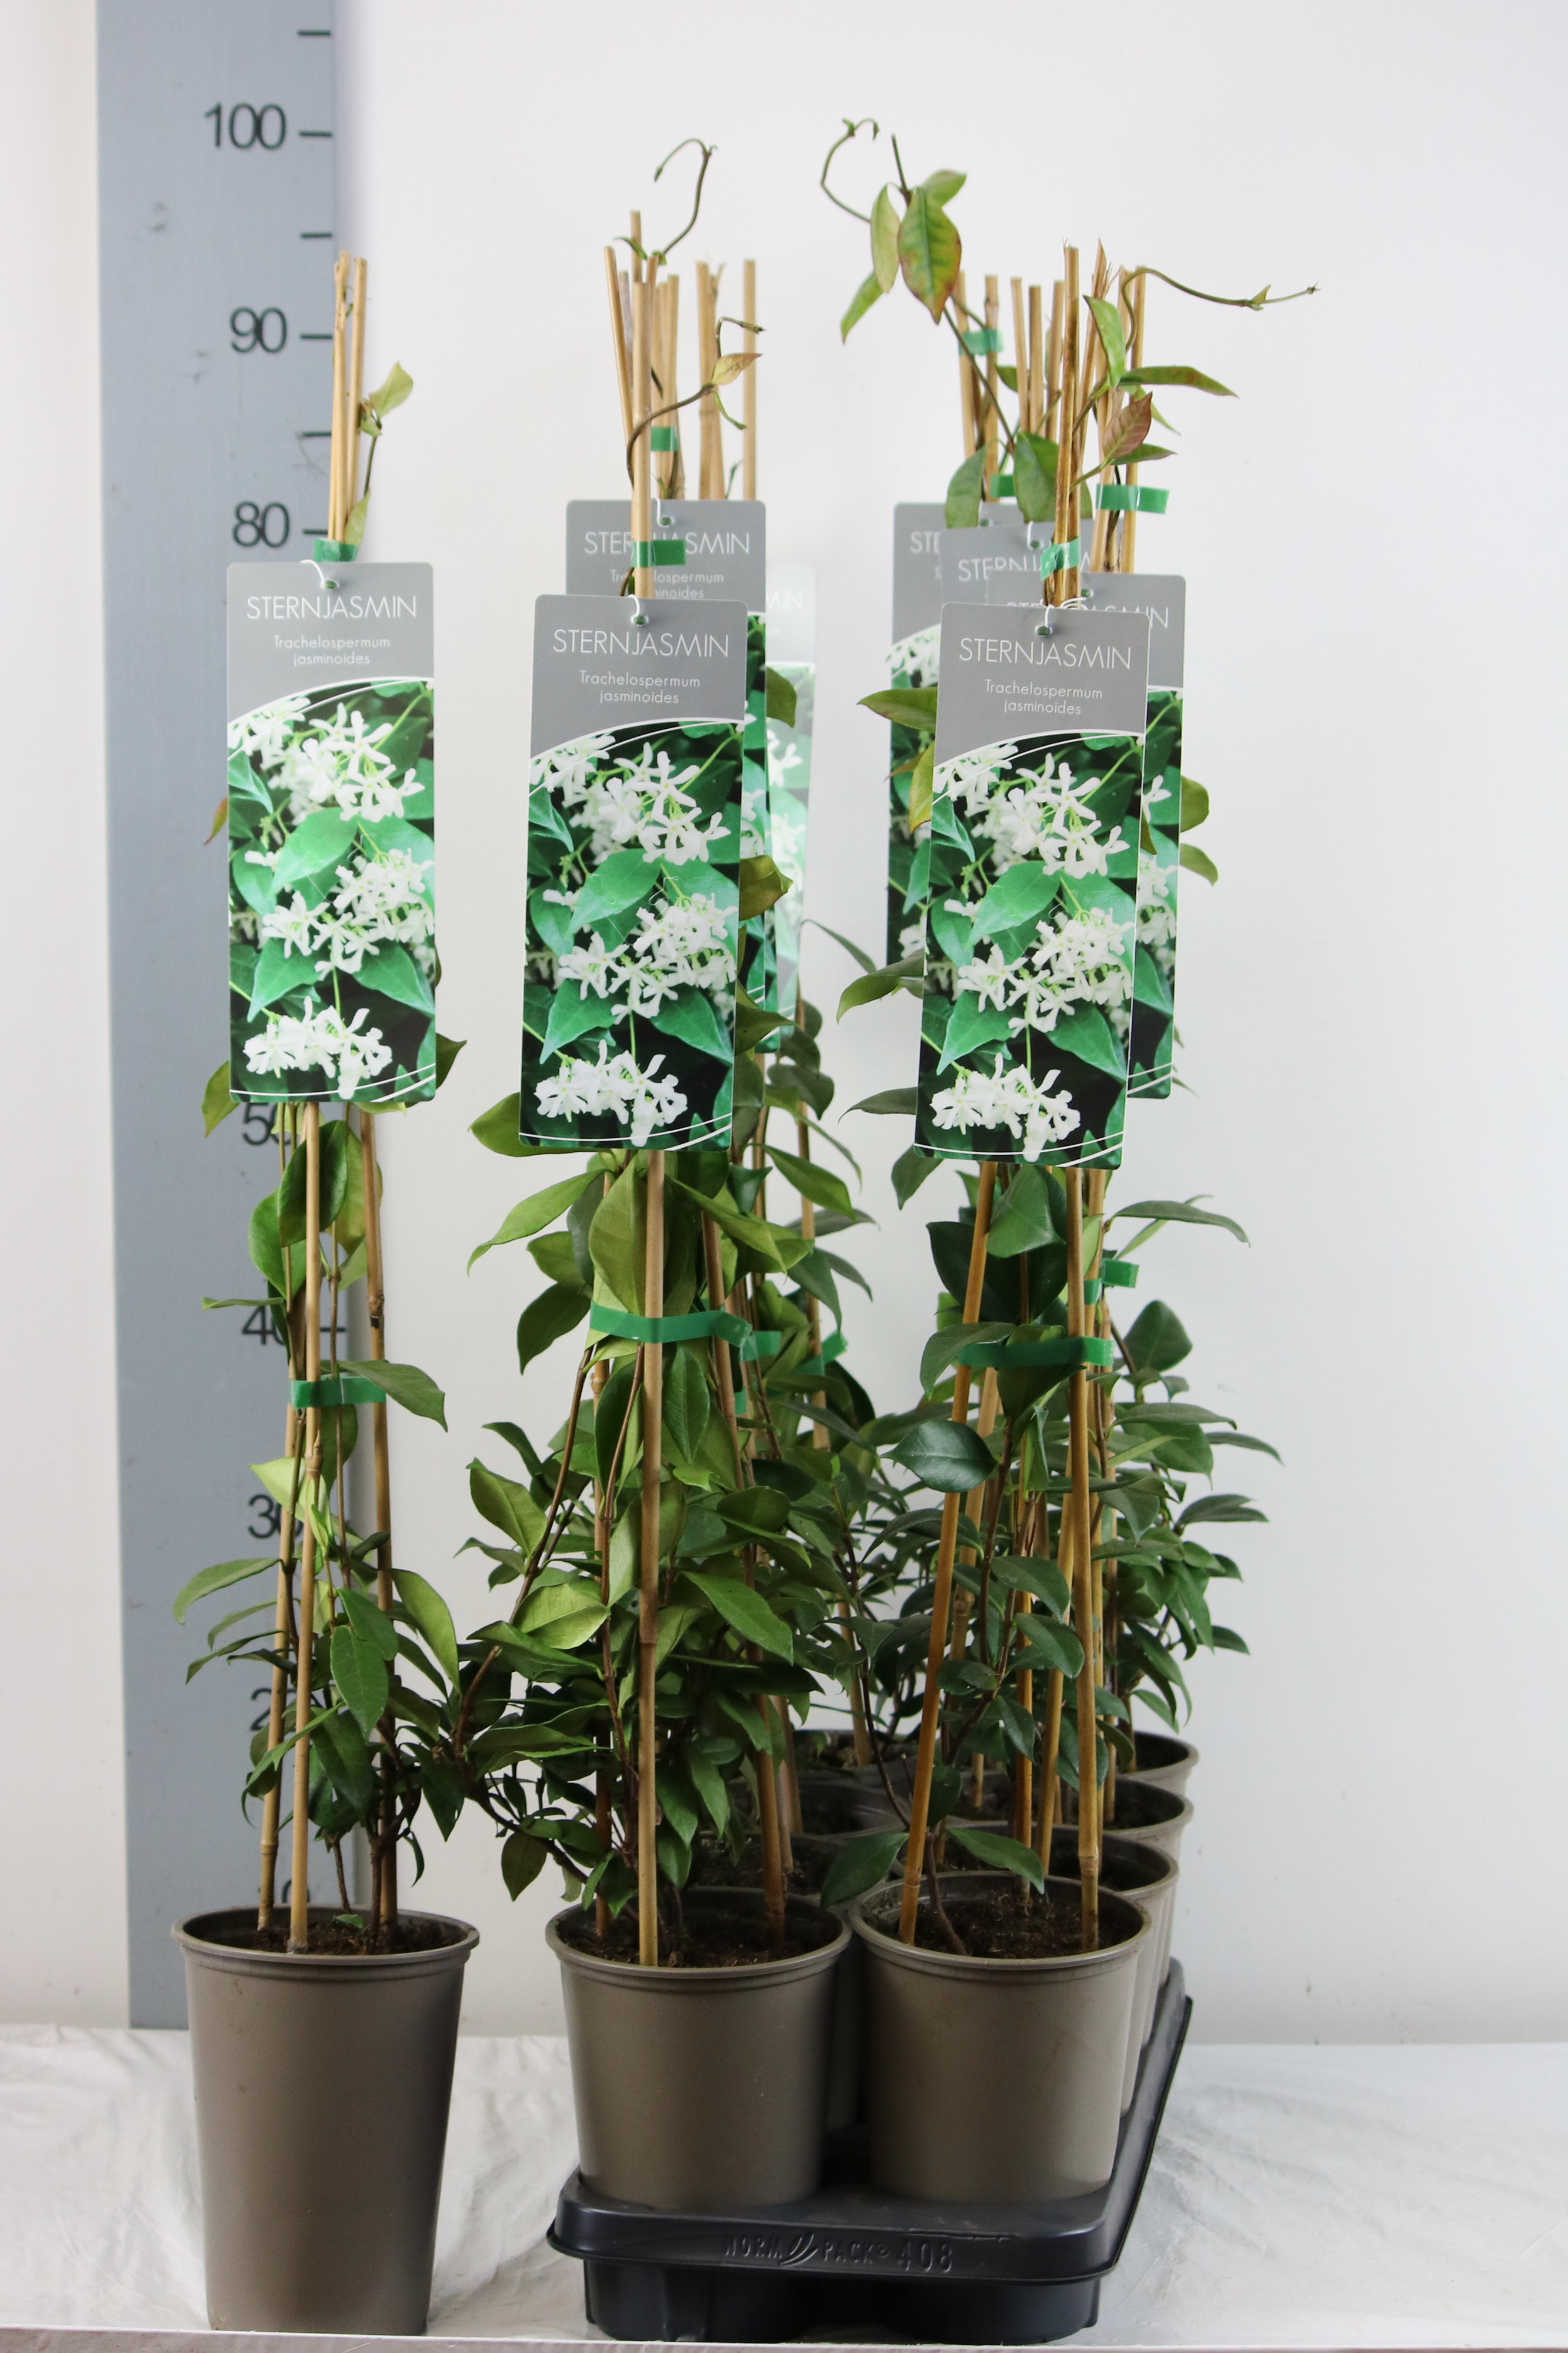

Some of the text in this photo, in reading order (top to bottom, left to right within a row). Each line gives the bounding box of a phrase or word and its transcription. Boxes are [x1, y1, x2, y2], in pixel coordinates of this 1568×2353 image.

[203, 102, 287, 149] 100
[230, 307, 287, 354] 90
[233, 501, 291, 548] 80
[584, 532, 749, 554] STERSMIN
[246, 595, 416, 618] STERNJASMIN
[273, 635, 390, 651] Trachelospermum
[552, 629, 728, 657] STERNJASMIN
[959, 638, 1131, 669] STERNJASMIN
[293, 651, 370, 666] jasminoides
[579, 670, 700, 688] Trachelospermum
[985, 679, 1103, 699] Trachelospermum
[600, 690, 679, 704] jasminoides
[1004, 699, 1081, 715] jasminoides
[241, 1305, 285, 1345] 4
[724, 2235, 783, 2258] NORM
[897, 2241, 952, 2274] 408
